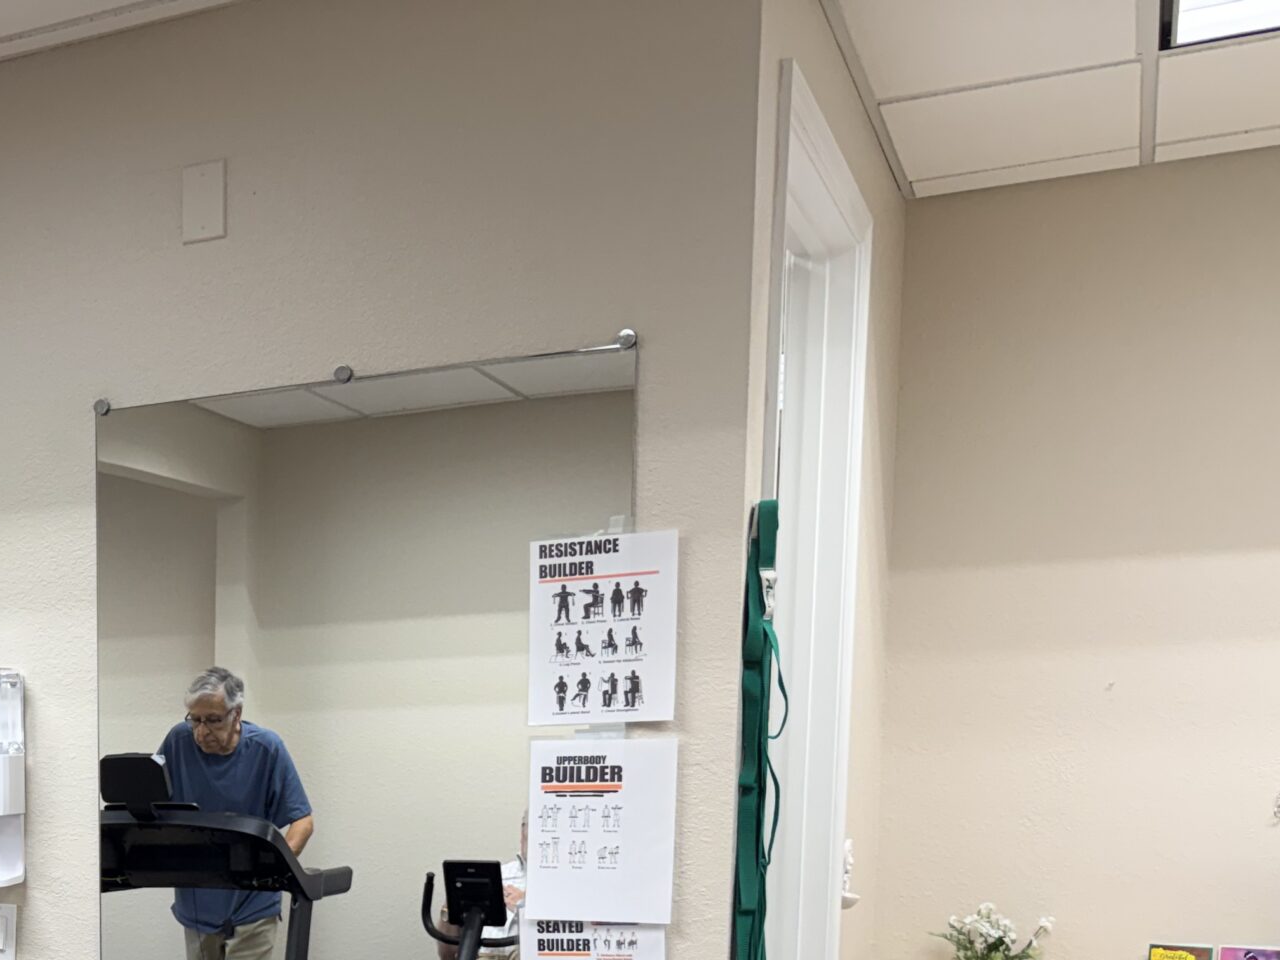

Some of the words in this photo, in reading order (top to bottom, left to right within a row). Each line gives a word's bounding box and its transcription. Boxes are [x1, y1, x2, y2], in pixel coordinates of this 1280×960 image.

[538, 538, 620, 559] RESISTANCE
[538, 560, 594, 579] BUILDER
[556, 755, 607, 765] UPPERBODY
[541, 765, 623, 783] BUILDER
[536, 920, 584, 934] SEATED
[537, 938, 591, 952] BUILDER
